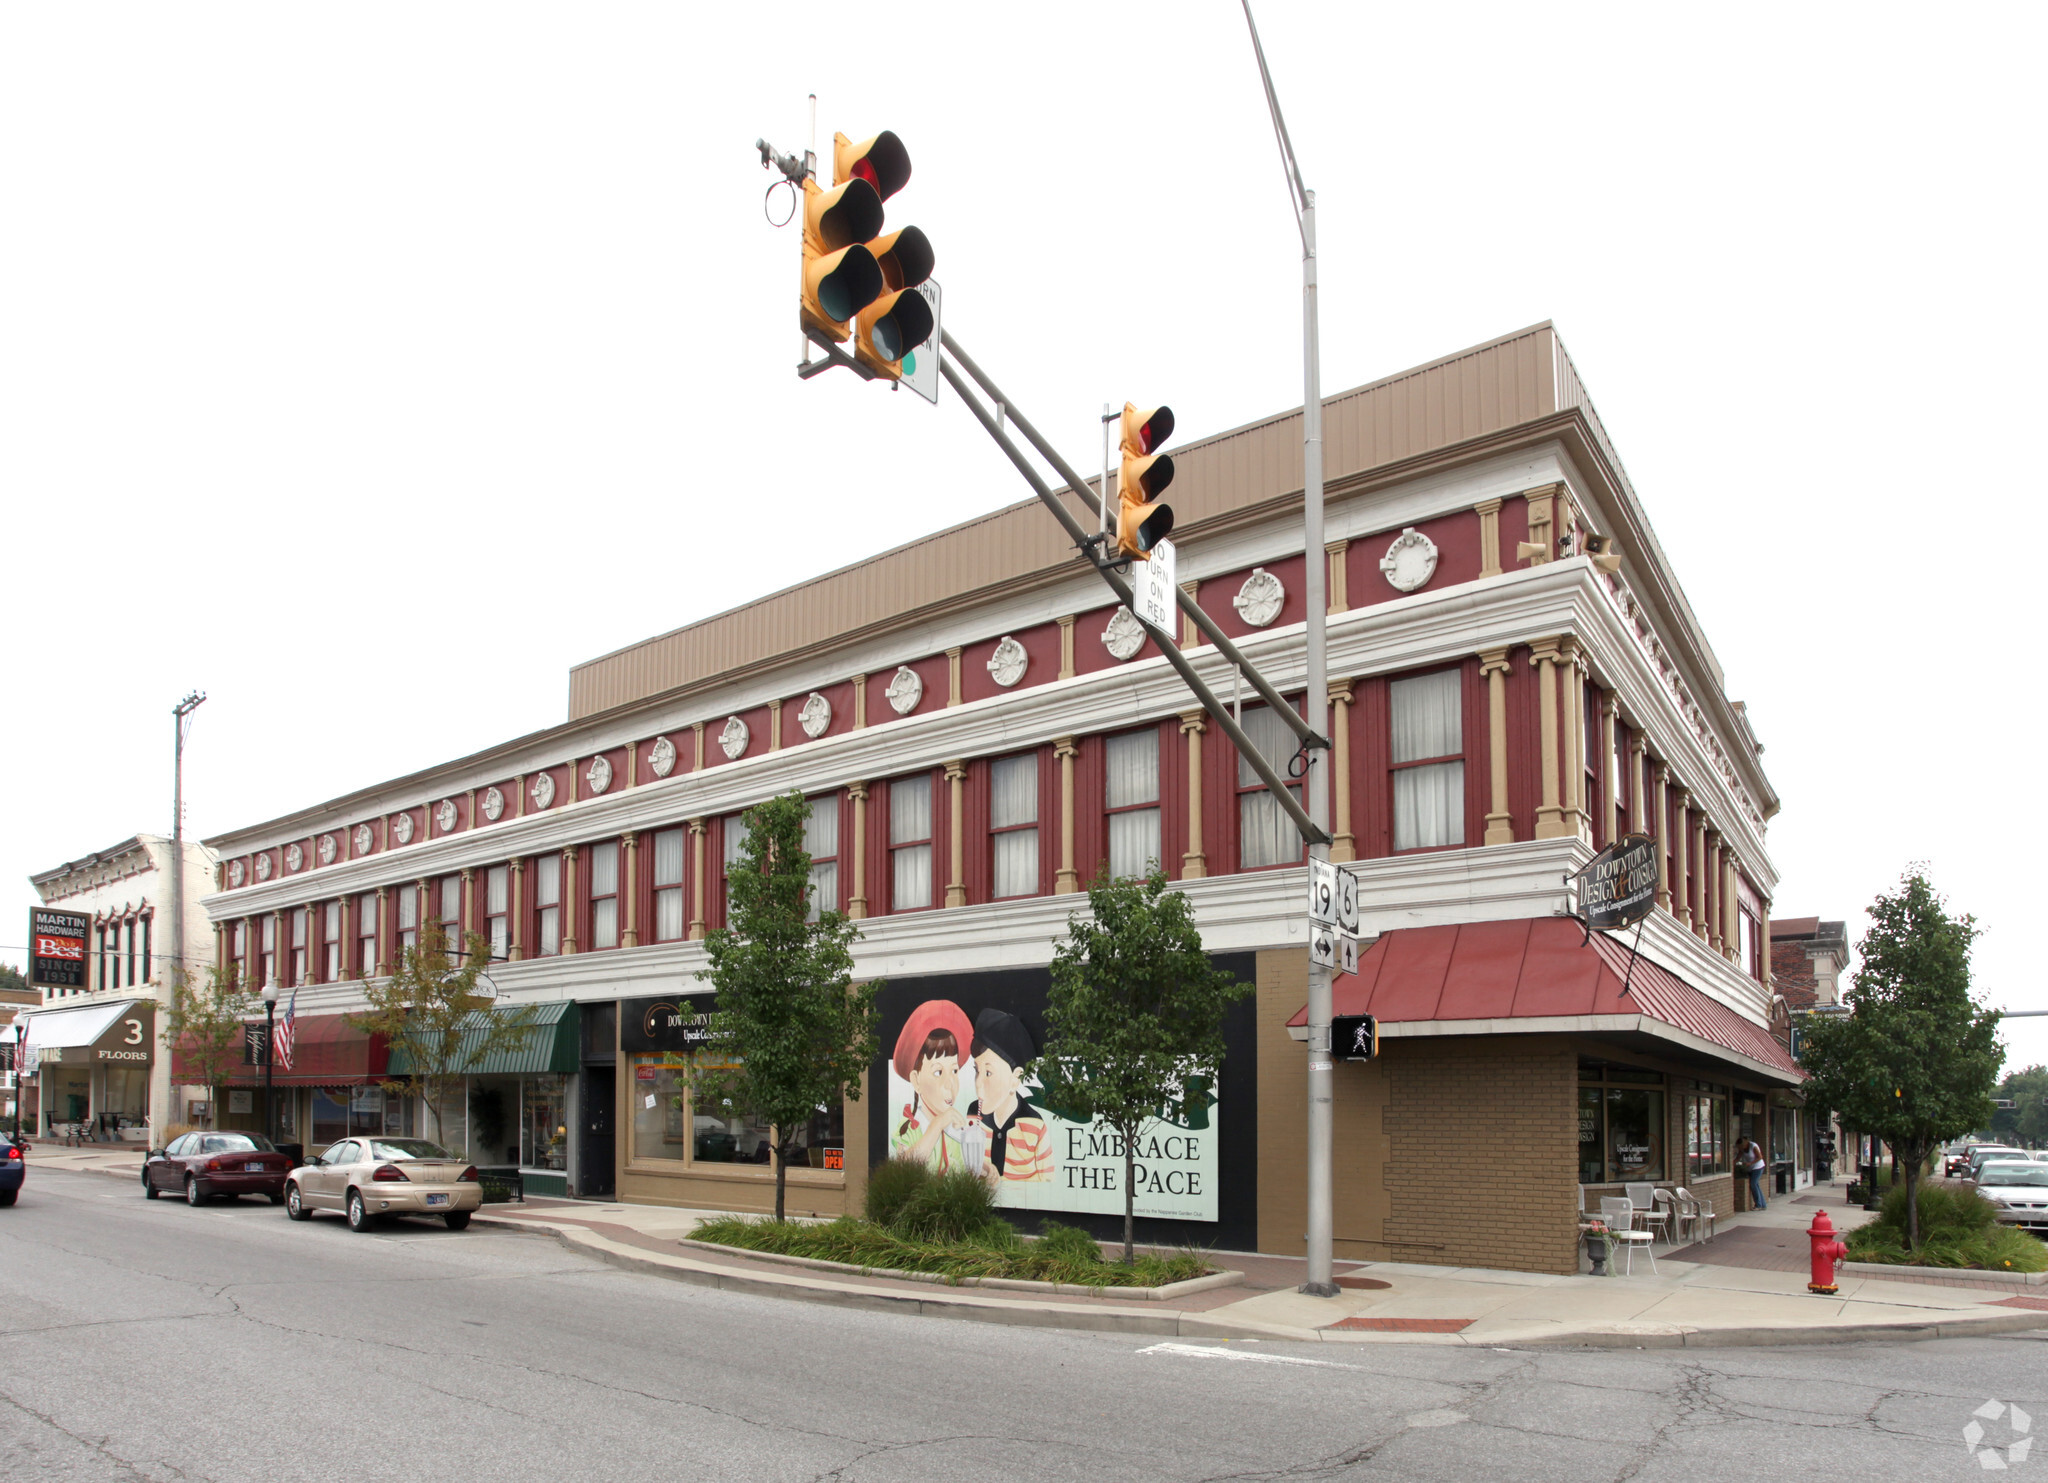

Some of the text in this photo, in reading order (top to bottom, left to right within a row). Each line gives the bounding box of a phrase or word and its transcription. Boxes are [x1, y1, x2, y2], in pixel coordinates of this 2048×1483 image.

[1150, 582, 1163, 601] ON
[1147, 599, 1165, 622] RED
[1596, 843, 1647, 880] DOWNTOWN
[1580, 876, 1618, 906] DESIGN
[1628, 845, 1658, 892] CONSIGN
[1314, 881, 1330, 916] 19
[1344, 884, 1351, 915] 6
[1590, 903, 1606, 917] Upscale
[1606, 896, 1633, 911] Consignment
[36, 913, 85, 928] MARTIN
[36, 924, 85, 938] HARDWARE
[38, 938, 82, 958] Best
[39, 959, 80, 972] SINCE
[44, 970, 75, 983] 1958
[123, 1019, 144, 1045] 3
[98, 1050, 148, 1061] FLOORS
[1065, 1127, 1201, 1161] EMBRACE
[825, 1156, 843, 1168] OPEN
[1063, 1164, 1203, 1198] THE PACE
